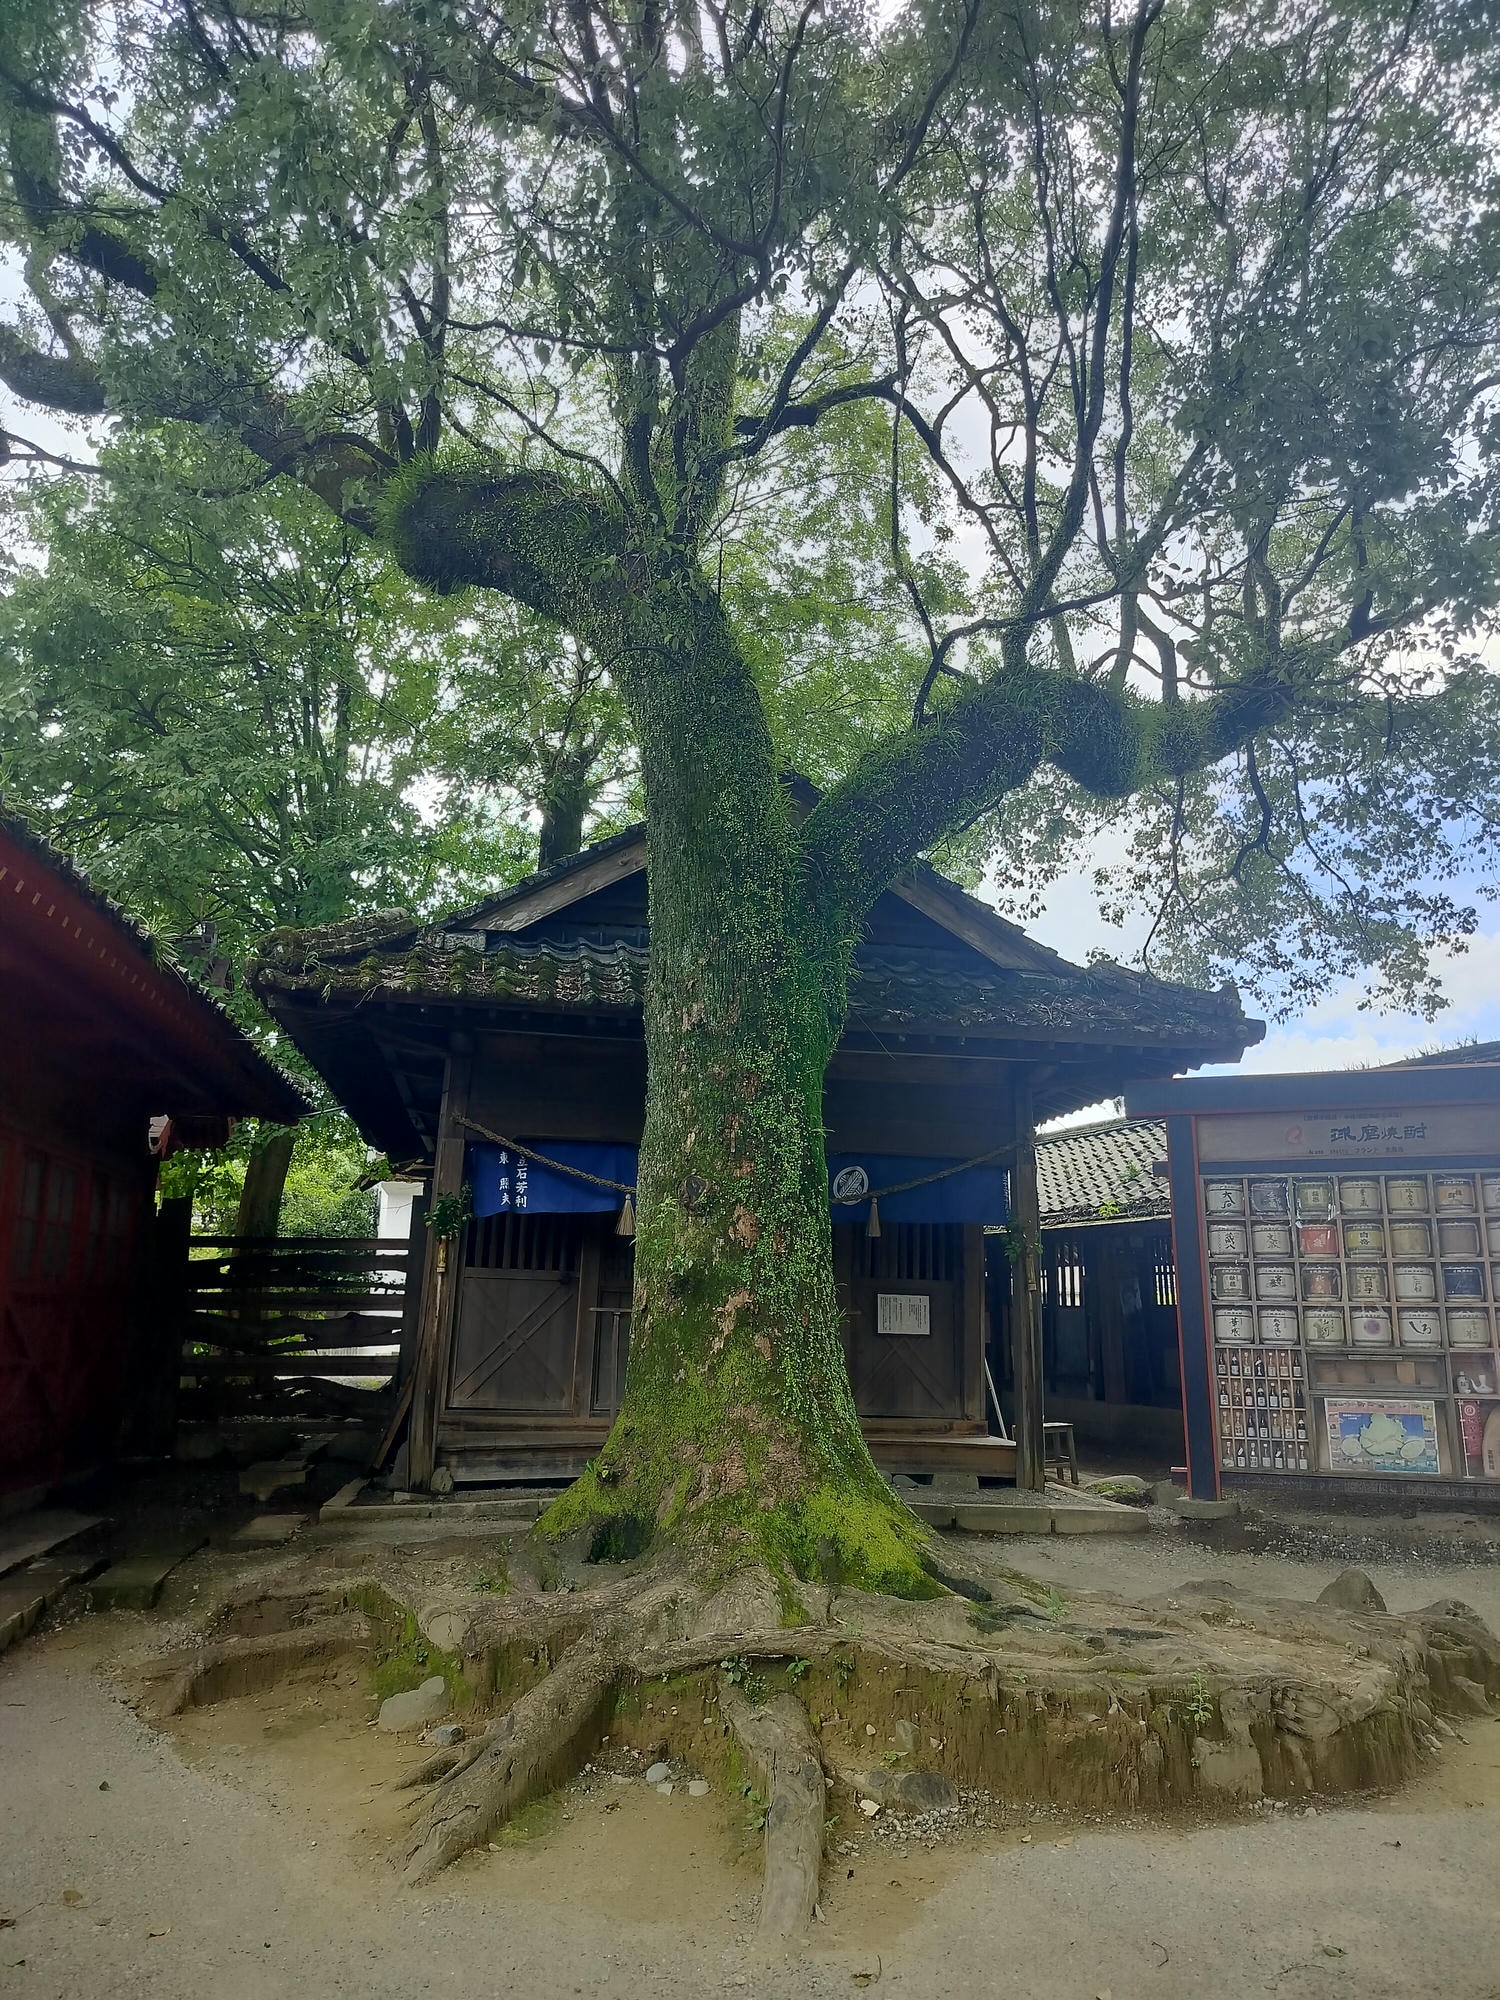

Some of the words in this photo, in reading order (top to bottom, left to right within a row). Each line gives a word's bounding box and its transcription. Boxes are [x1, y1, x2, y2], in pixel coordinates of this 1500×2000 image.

[1330, 1122, 1428, 1142] 球磨焼酎
[515, 1155, 528, 1208] 立石芳利
